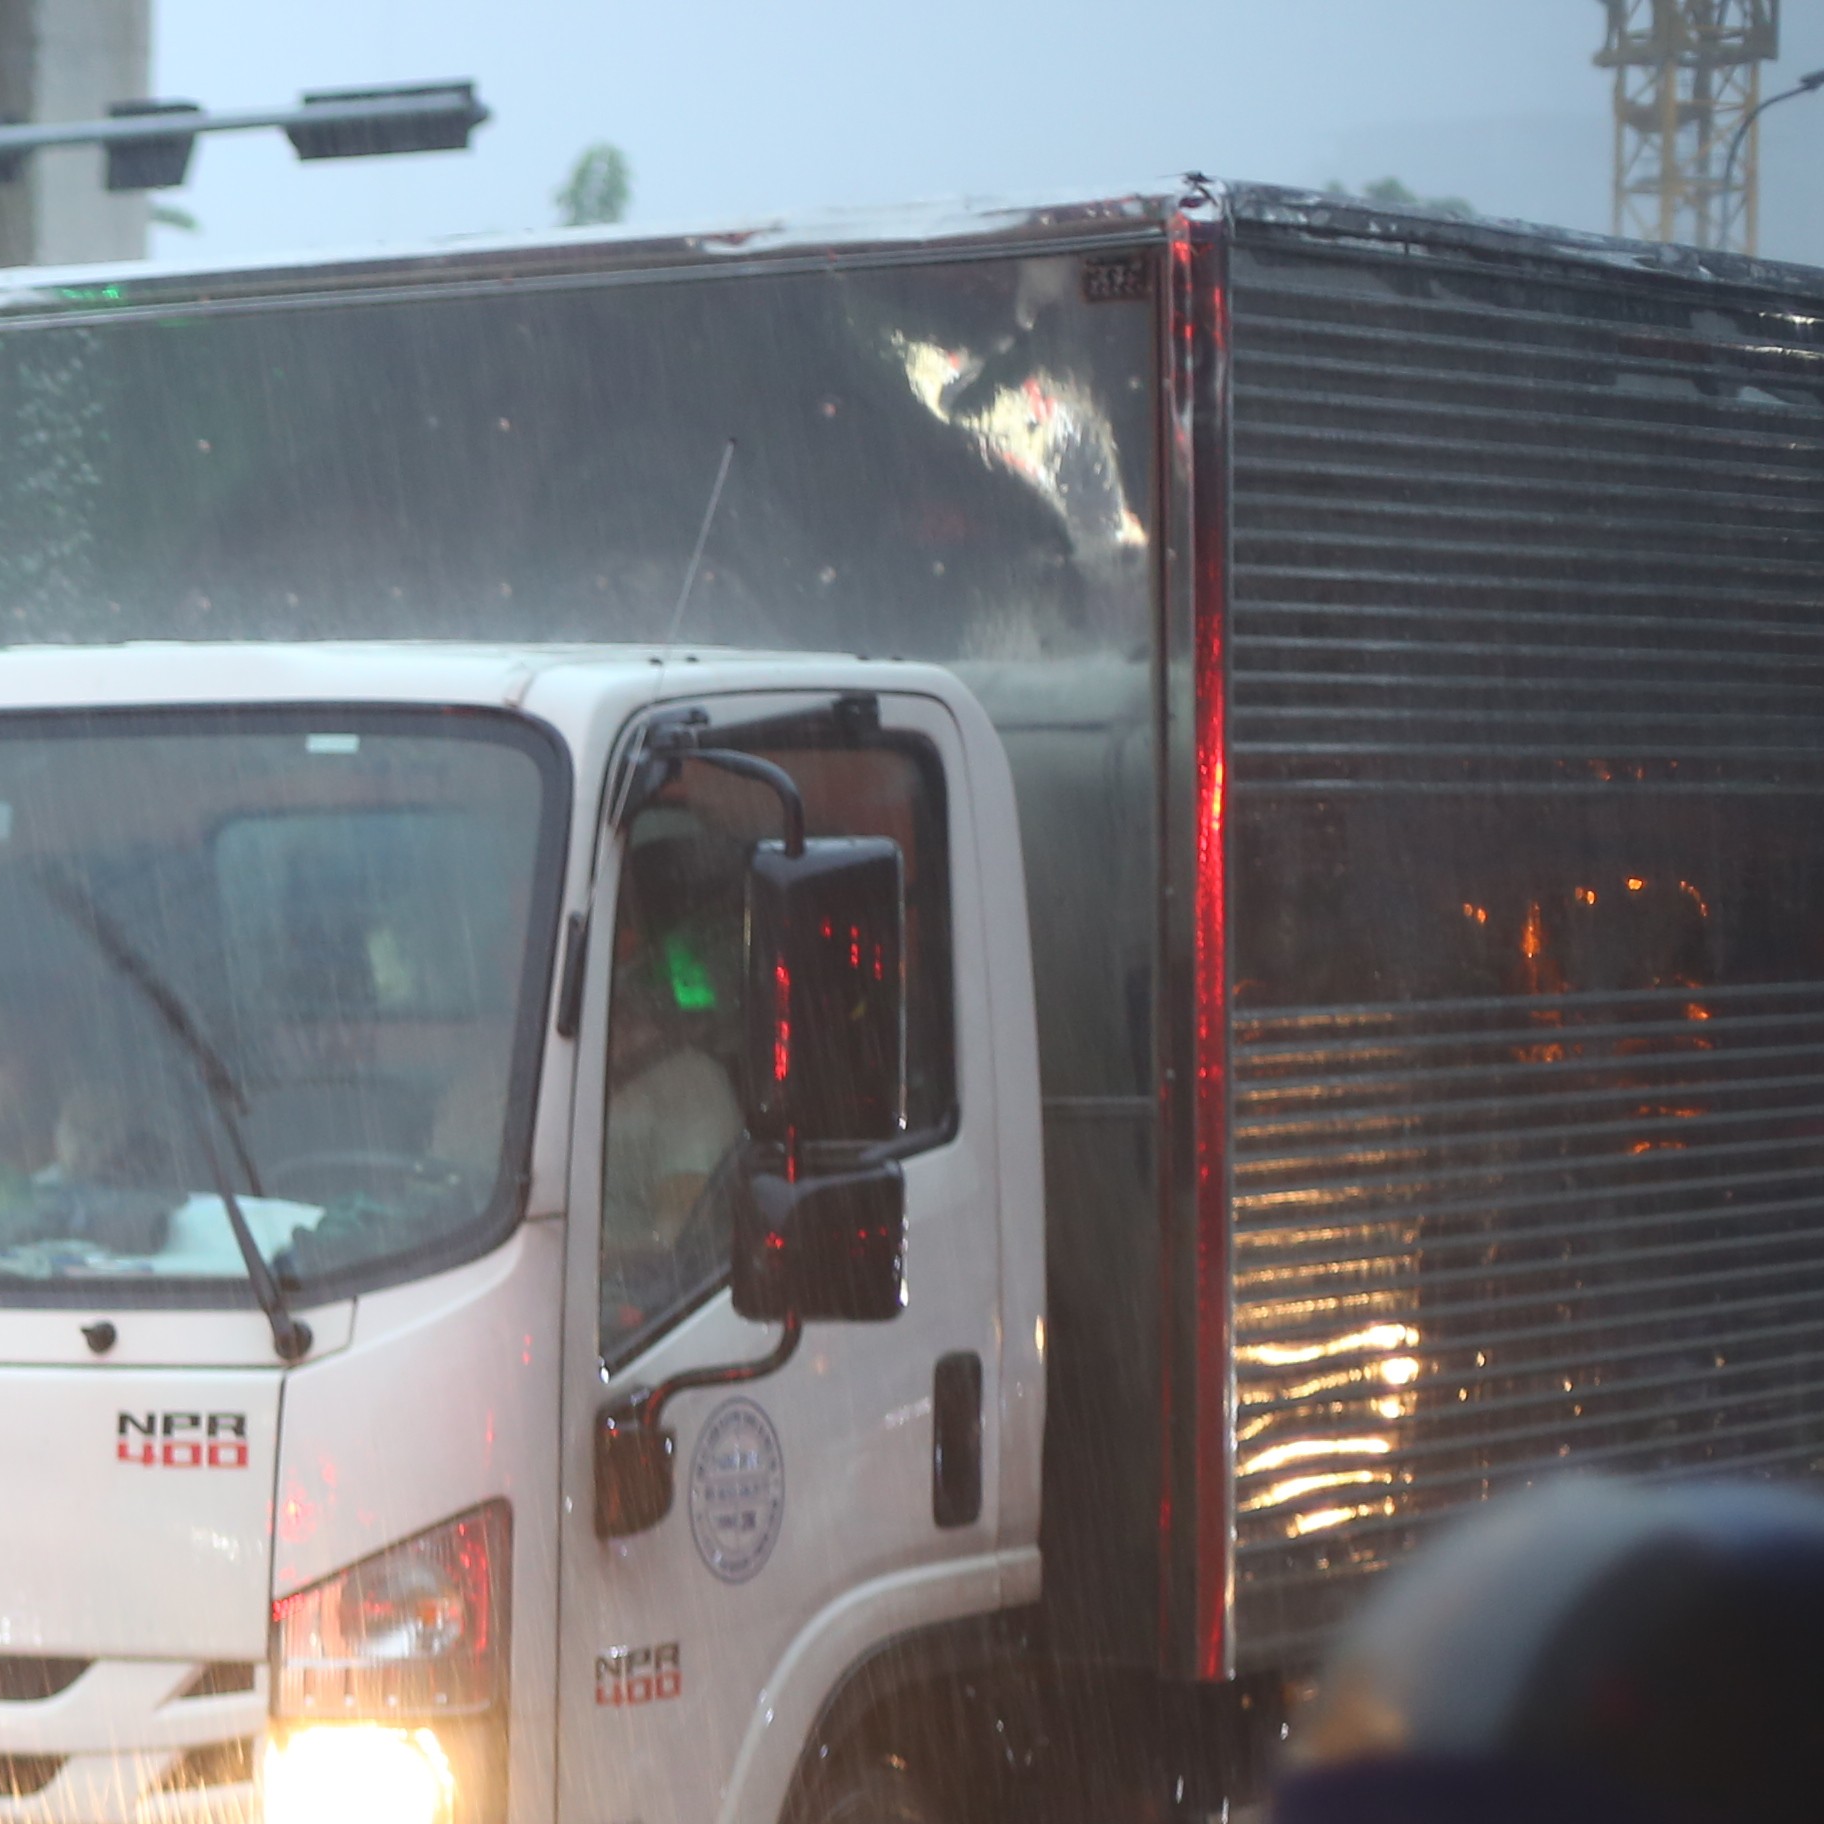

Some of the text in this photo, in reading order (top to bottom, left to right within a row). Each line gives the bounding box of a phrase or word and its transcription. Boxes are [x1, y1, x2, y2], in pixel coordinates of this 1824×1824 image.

[117, 1411, 247, 1438] NPR
[116, 1441, 250, 1469] 400
[595, 1643, 681, 1681] NPR
[595, 1670, 683, 1708] 400
